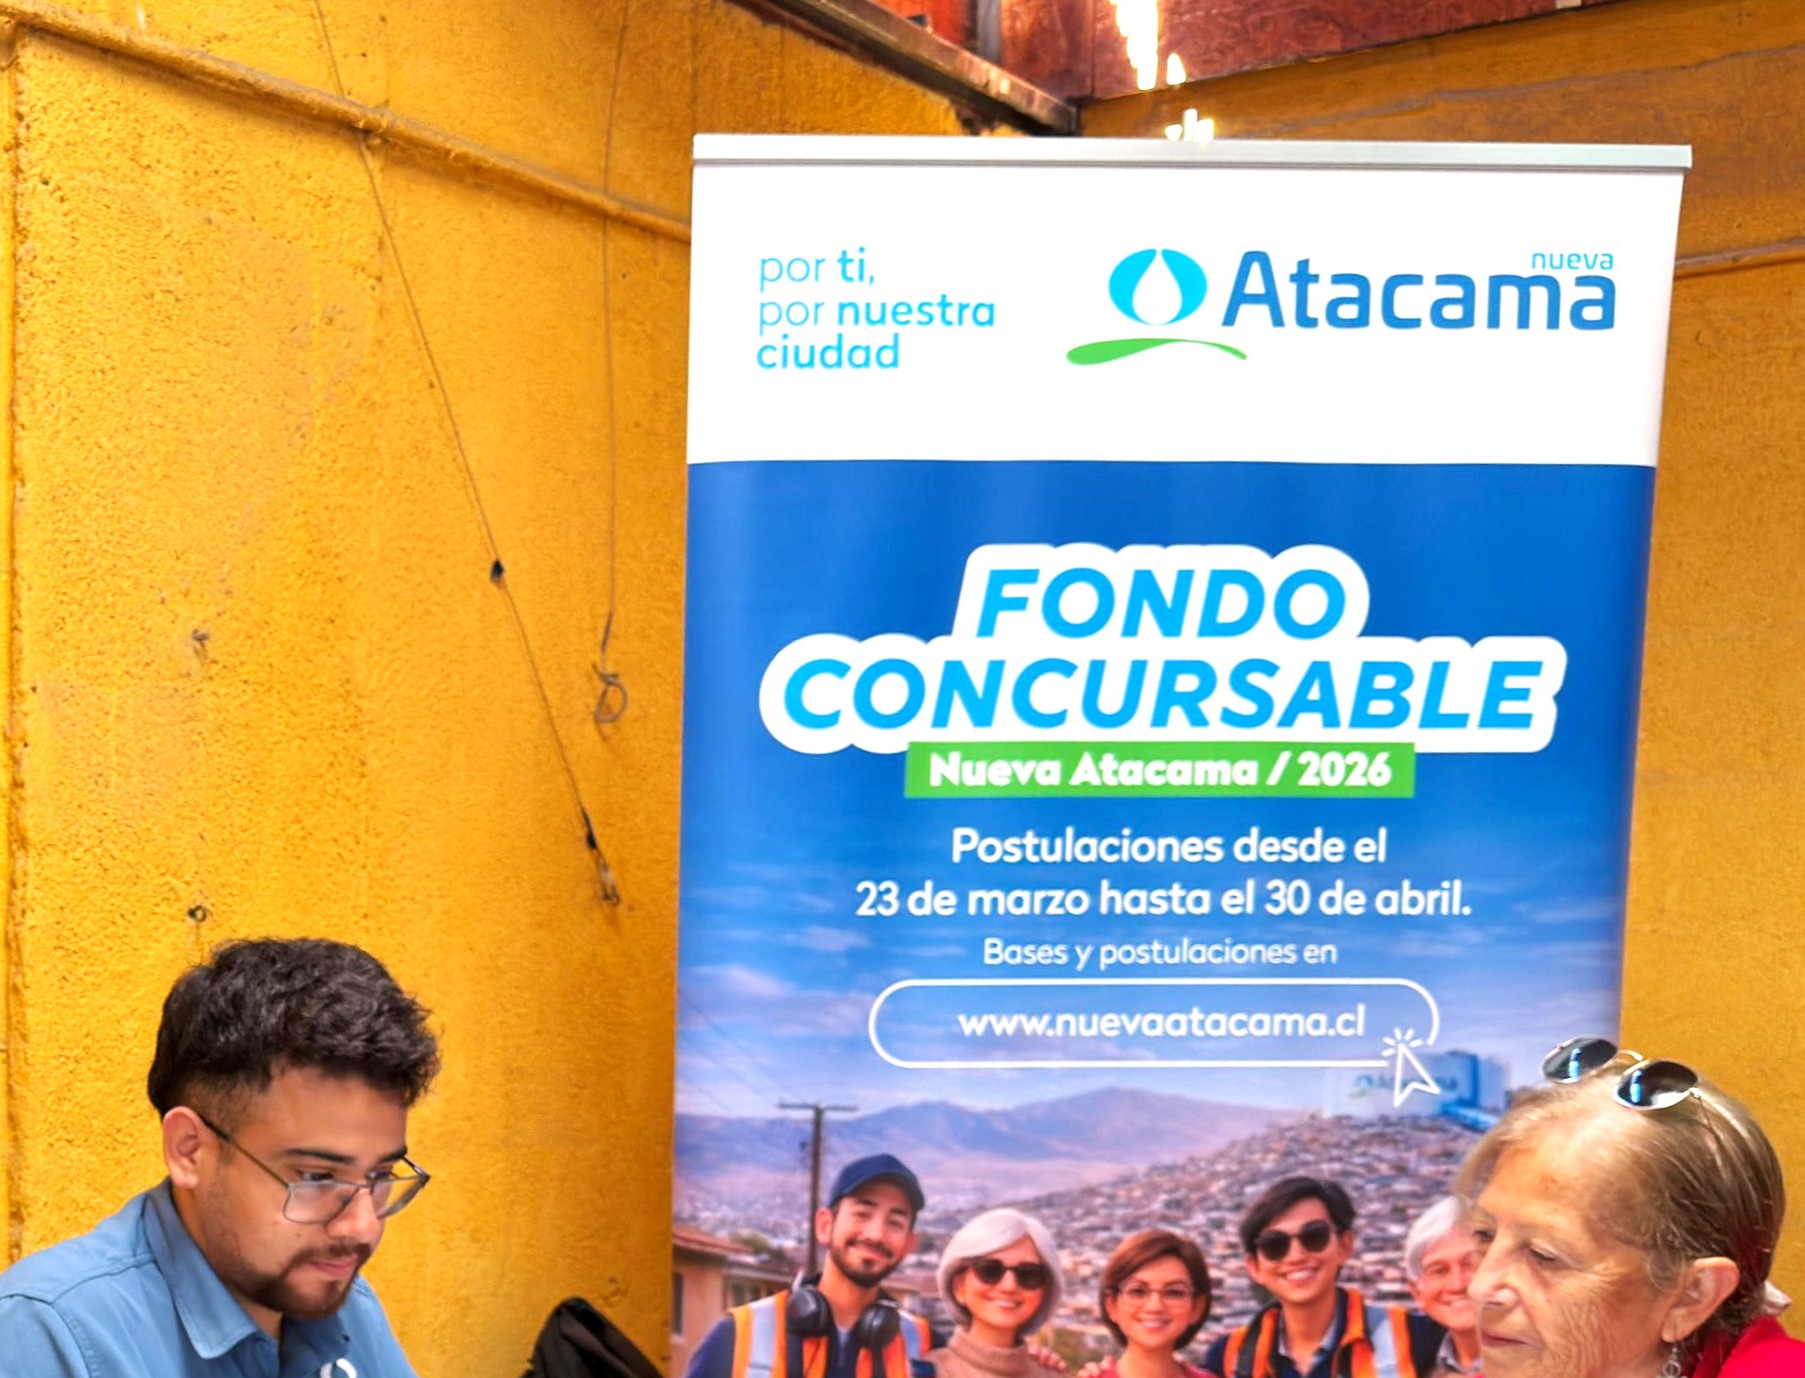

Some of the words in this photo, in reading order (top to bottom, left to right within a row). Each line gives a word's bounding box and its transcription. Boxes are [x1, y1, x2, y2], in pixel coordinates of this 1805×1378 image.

[759, 257, 827, 293] por
[837, 246, 875, 287] ti,
[1531, 252, 1615, 270] nueva
[1220, 250, 1617, 331] Atacama
[758, 300, 826, 337] por
[837, 293, 996, 327] nuestra
[756, 332, 900, 370] ciudad
[976, 567, 1347, 639] FONDO
[783, 658, 1545, 731] CONCURSABLE
[929, 751, 1061, 787] Nueva
[1069, 751, 1260, 787] Atacama
[1266, 750, 1292, 787] /
[1296, 750, 1393, 787] 2026
[951, 827, 1225, 864] Postulaciones
[1232, 826, 1346, 864] desde
[1353, 826, 1388, 863] el
[855, 880, 901, 917] 23
[906, 879, 958, 917] de
[967, 889, 1092, 917] marzo
[1099, 878, 1211, 916] hasta
[1220, 878, 1255, 915] el
[1264, 878, 1312, 916] 30
[1318, 878, 1367, 916] de
[1374, 878, 1473, 916] abril.
[983, 937, 1069, 966] Bases
[1074, 944, 1094, 973] y
[1099, 936, 1298, 972] postulaciones
[1303, 944, 1339, 966] en
[957, 1002, 1367, 1039] www.nuevaatacama.cl
